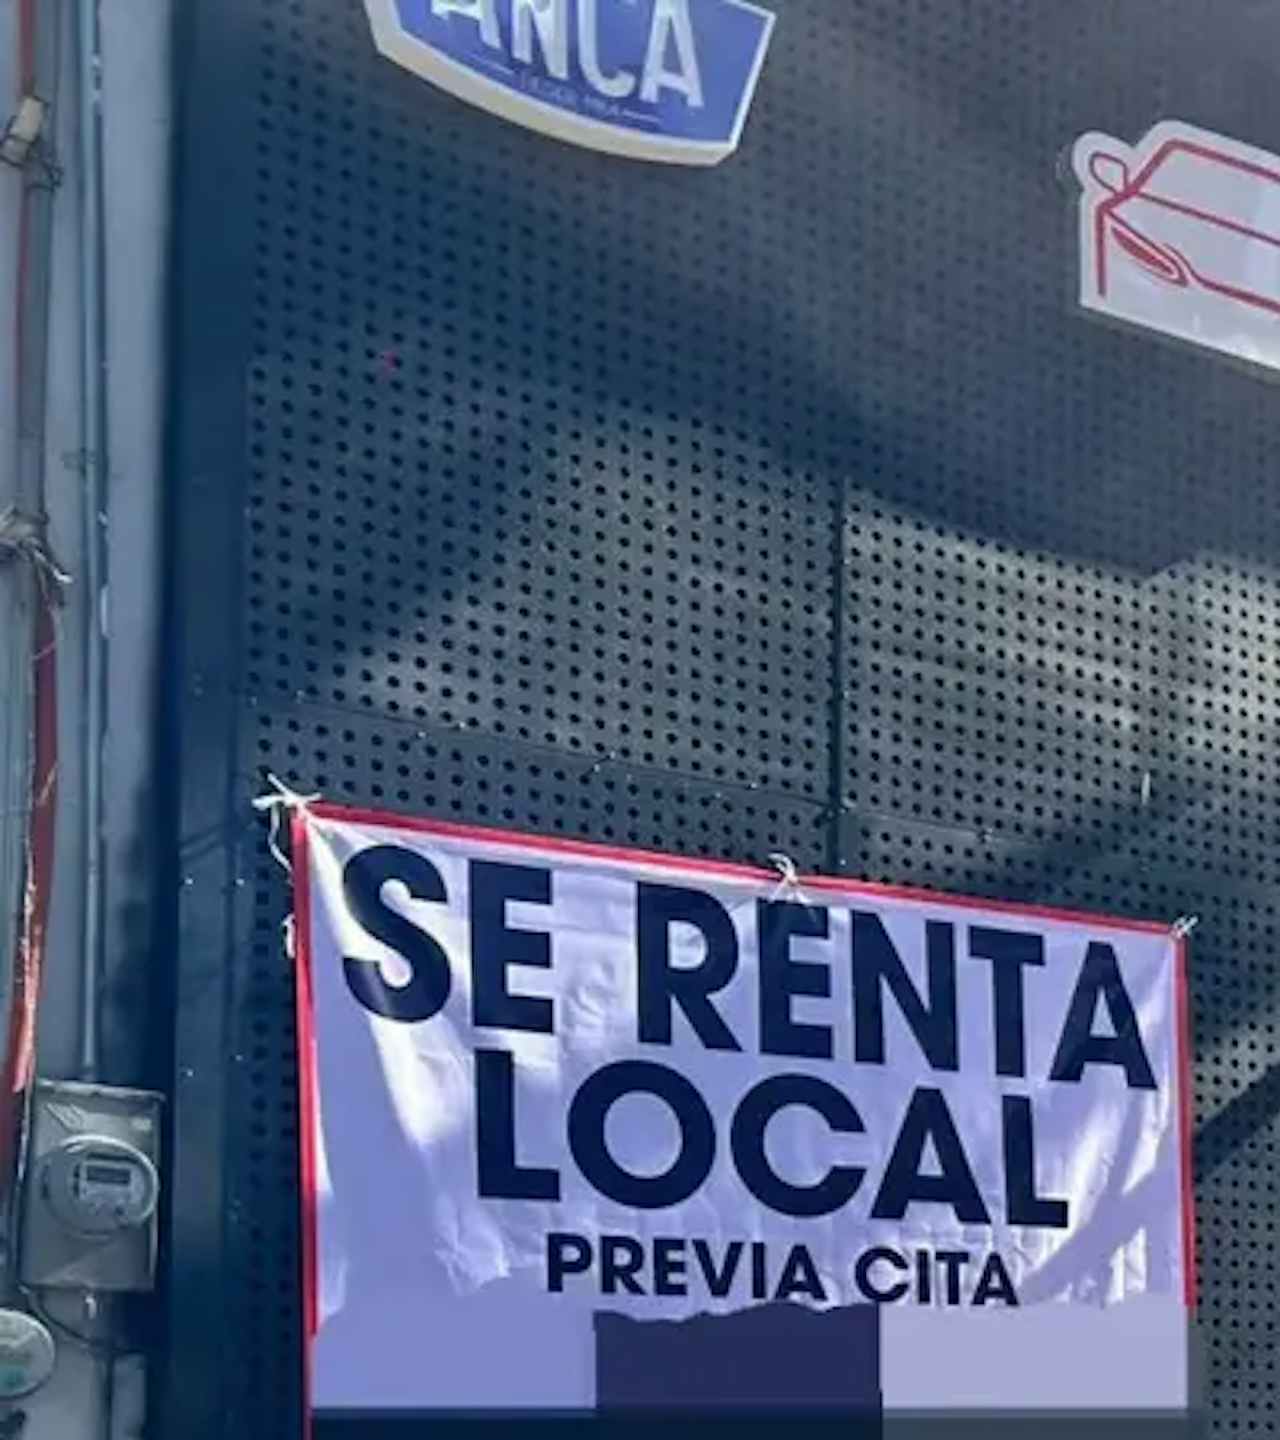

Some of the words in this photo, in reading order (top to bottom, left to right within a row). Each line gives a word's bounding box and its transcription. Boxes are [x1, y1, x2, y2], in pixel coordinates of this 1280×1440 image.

[342, 844, 554, 1034] SE
[635, 880, 1157, 1091] RENTA
[475, 1048, 1069, 1229] LOCAL
[546, 1233, 828, 1302] PREVIA
[854, 1246, 1021, 1307] CITA
